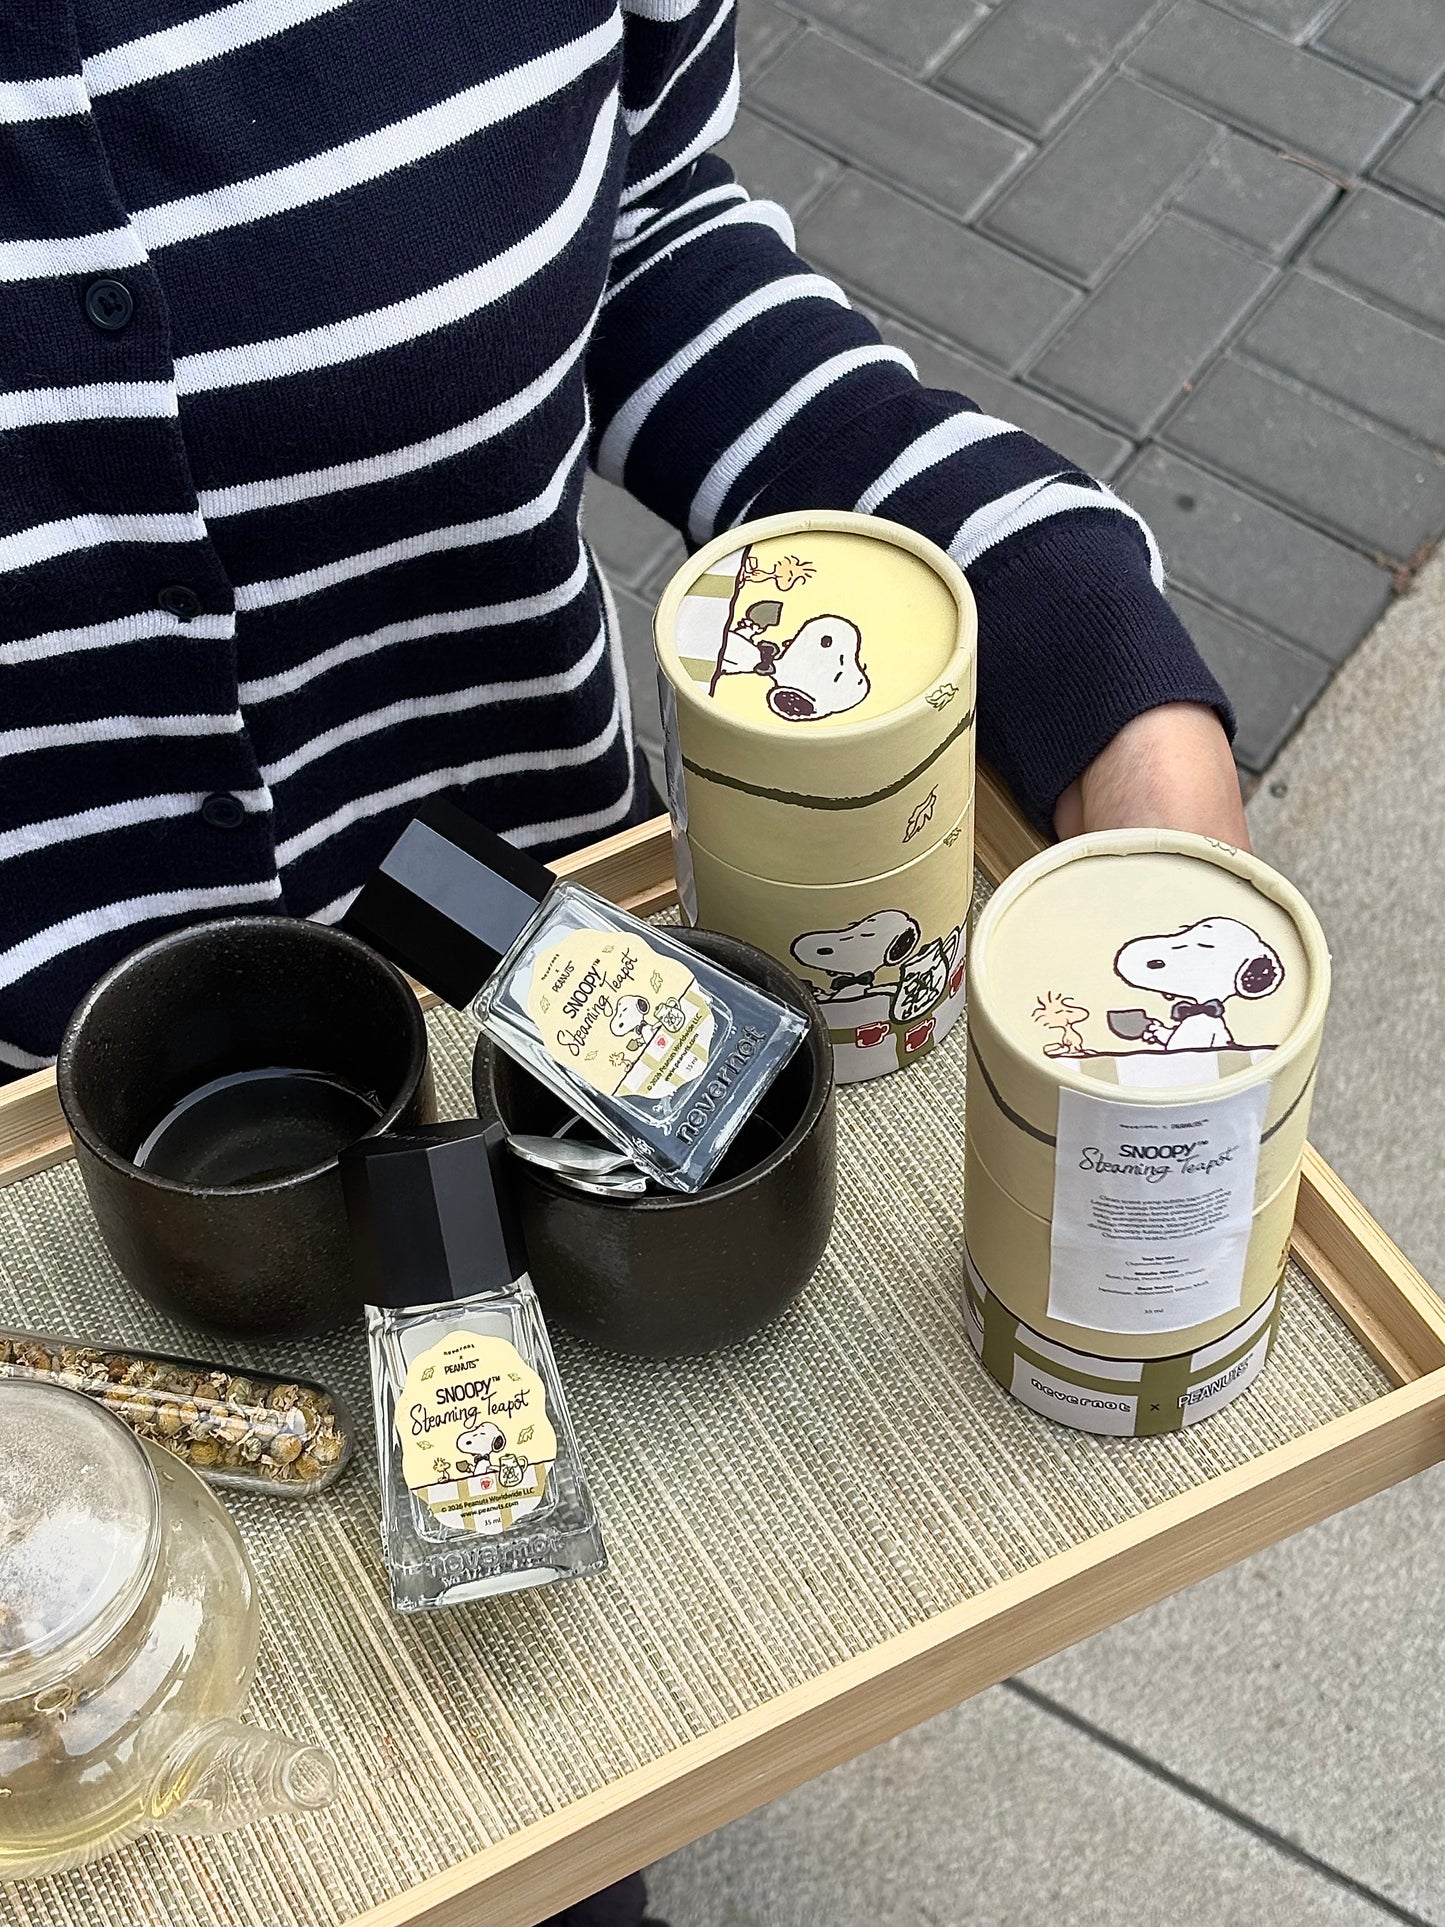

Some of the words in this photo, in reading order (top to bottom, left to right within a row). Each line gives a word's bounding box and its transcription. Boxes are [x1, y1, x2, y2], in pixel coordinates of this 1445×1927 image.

[556, 995, 614, 1057] Steaming
[598, 947, 638, 993] Teapot
[675, 1025, 767, 1146] nevernot
[1079, 1146, 1174, 1184] Steaming
[1176, 1145, 1240, 1175] Teapot
[410, 1403, 482, 1436] Steaming
[481, 1389, 530, 1419] Teapot
[1031, 1378, 1131, 1413] nevernot
[460, 1500, 519, 1518] www.peanuts.com
[464, 1499, 489, 1509] Peanuts
[489, 1490, 522, 1504] Worldwide
[522, 1487, 535, 1495] LLC
